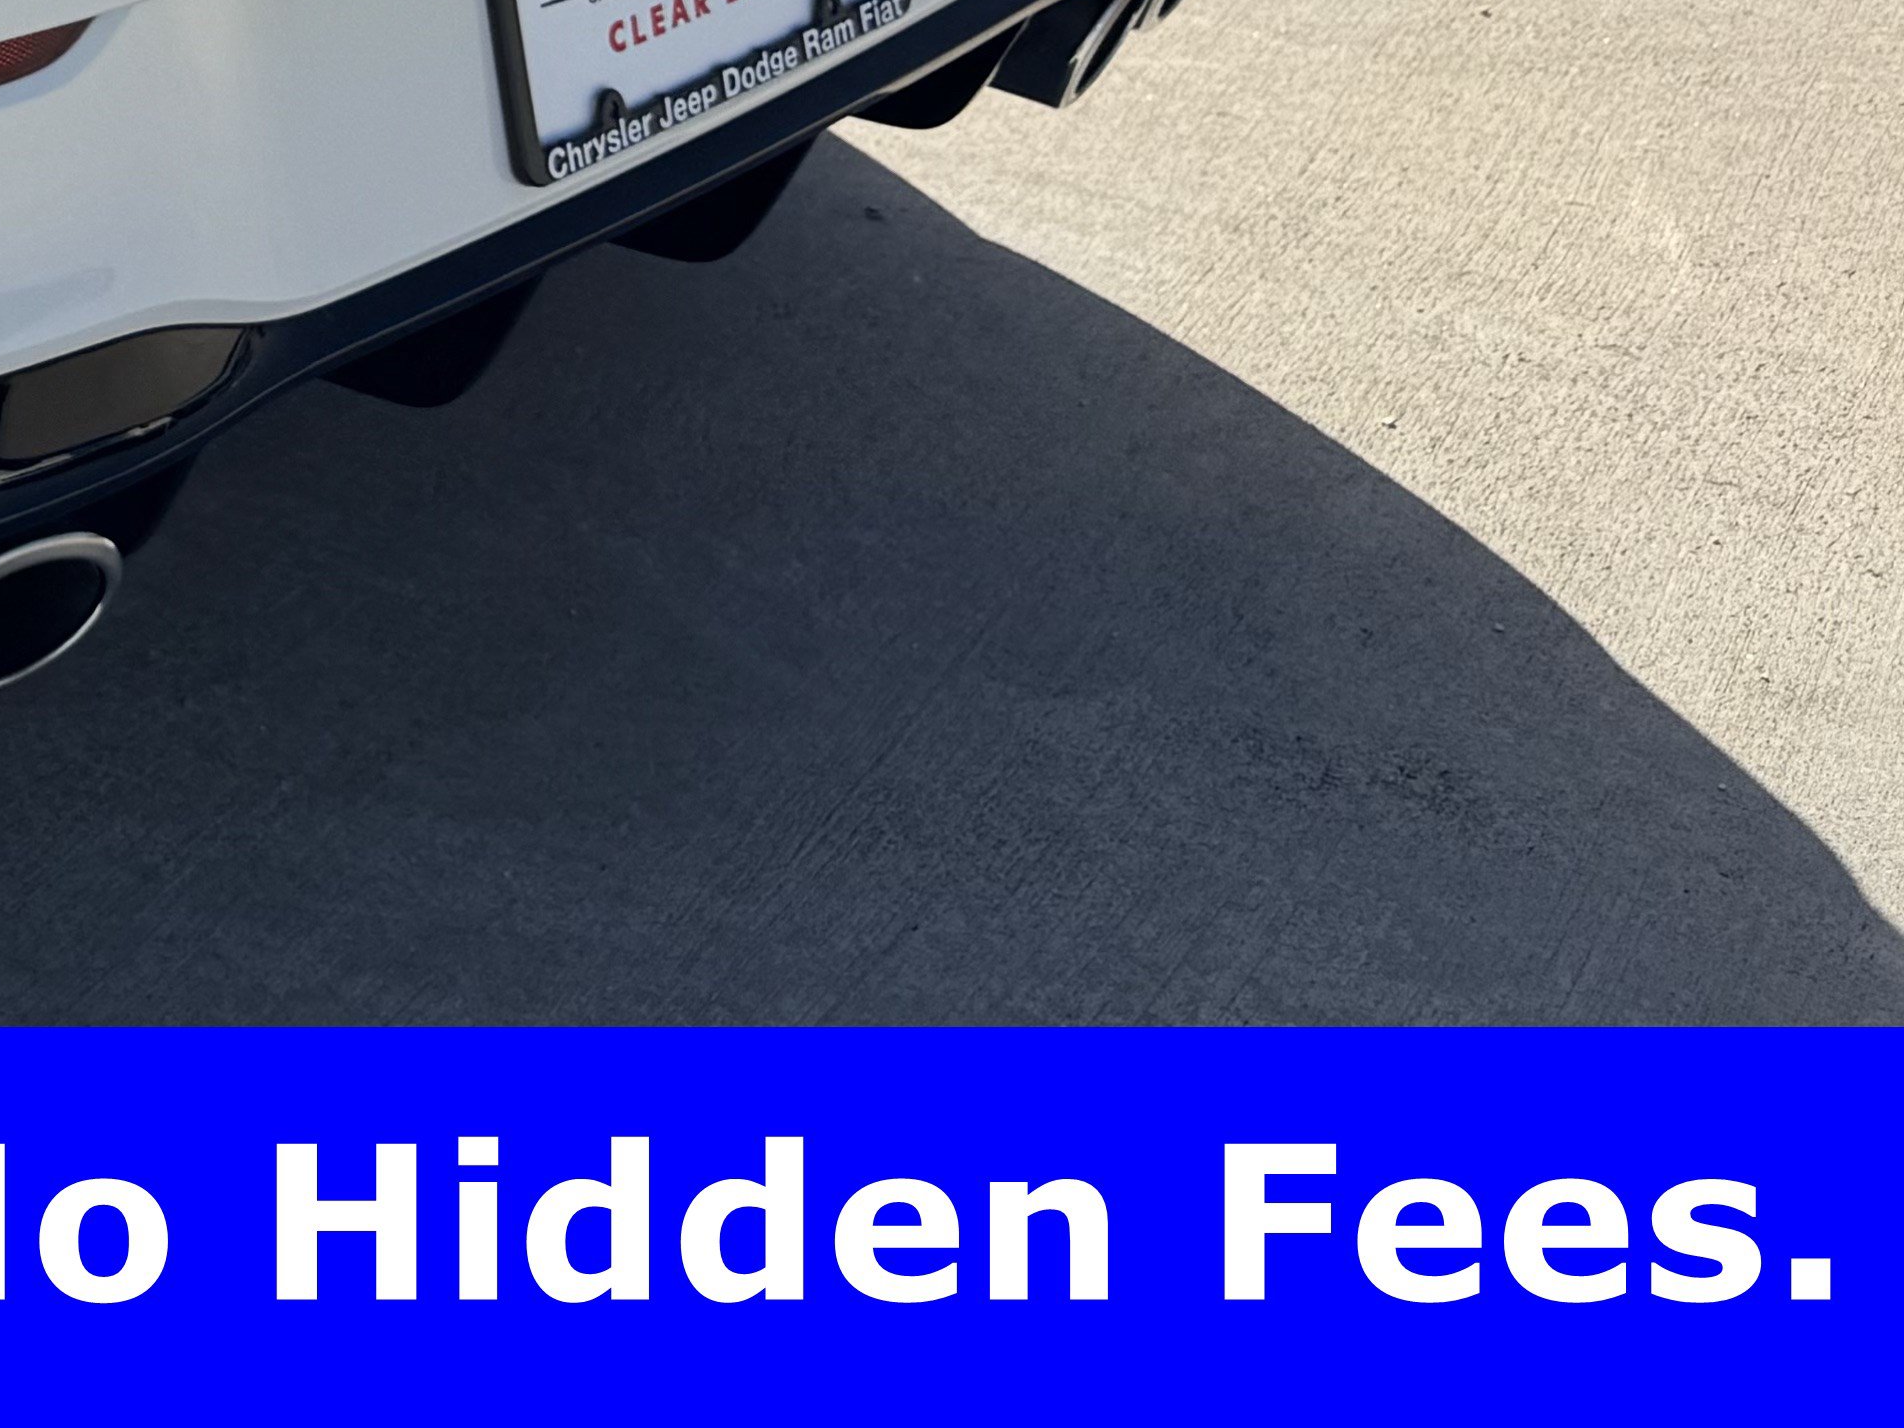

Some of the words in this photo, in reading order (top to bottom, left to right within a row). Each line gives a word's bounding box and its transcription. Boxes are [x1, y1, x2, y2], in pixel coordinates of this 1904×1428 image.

[548, 111, 653, 180] Chrysler
[659, 84, 718, 129] Jeep
[722, 46, 798, 99] Dodge
[802, 17, 856, 61] Ram
